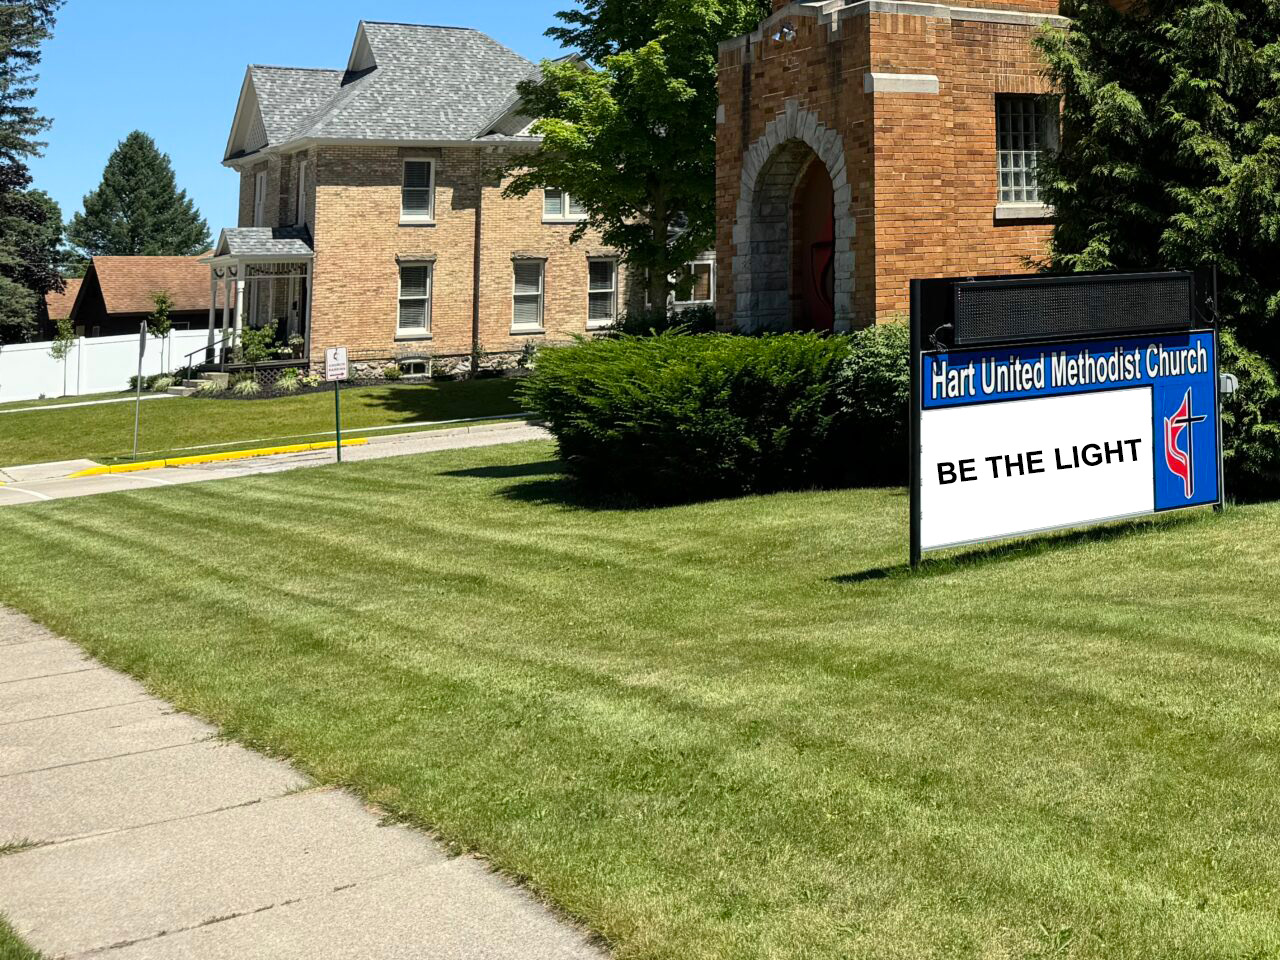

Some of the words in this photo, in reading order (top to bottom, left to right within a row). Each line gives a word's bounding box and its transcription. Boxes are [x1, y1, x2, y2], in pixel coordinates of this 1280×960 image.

[931, 359, 975, 399] Hart
[982, 353, 1044, 393] United
[1051, 346, 1141, 387] Methodist
[1146, 340, 1208, 377] Church
[936, 458, 977, 485] BE
[985, 450, 1045, 479] THE
[1054, 438, 1142, 470] LIGHT
